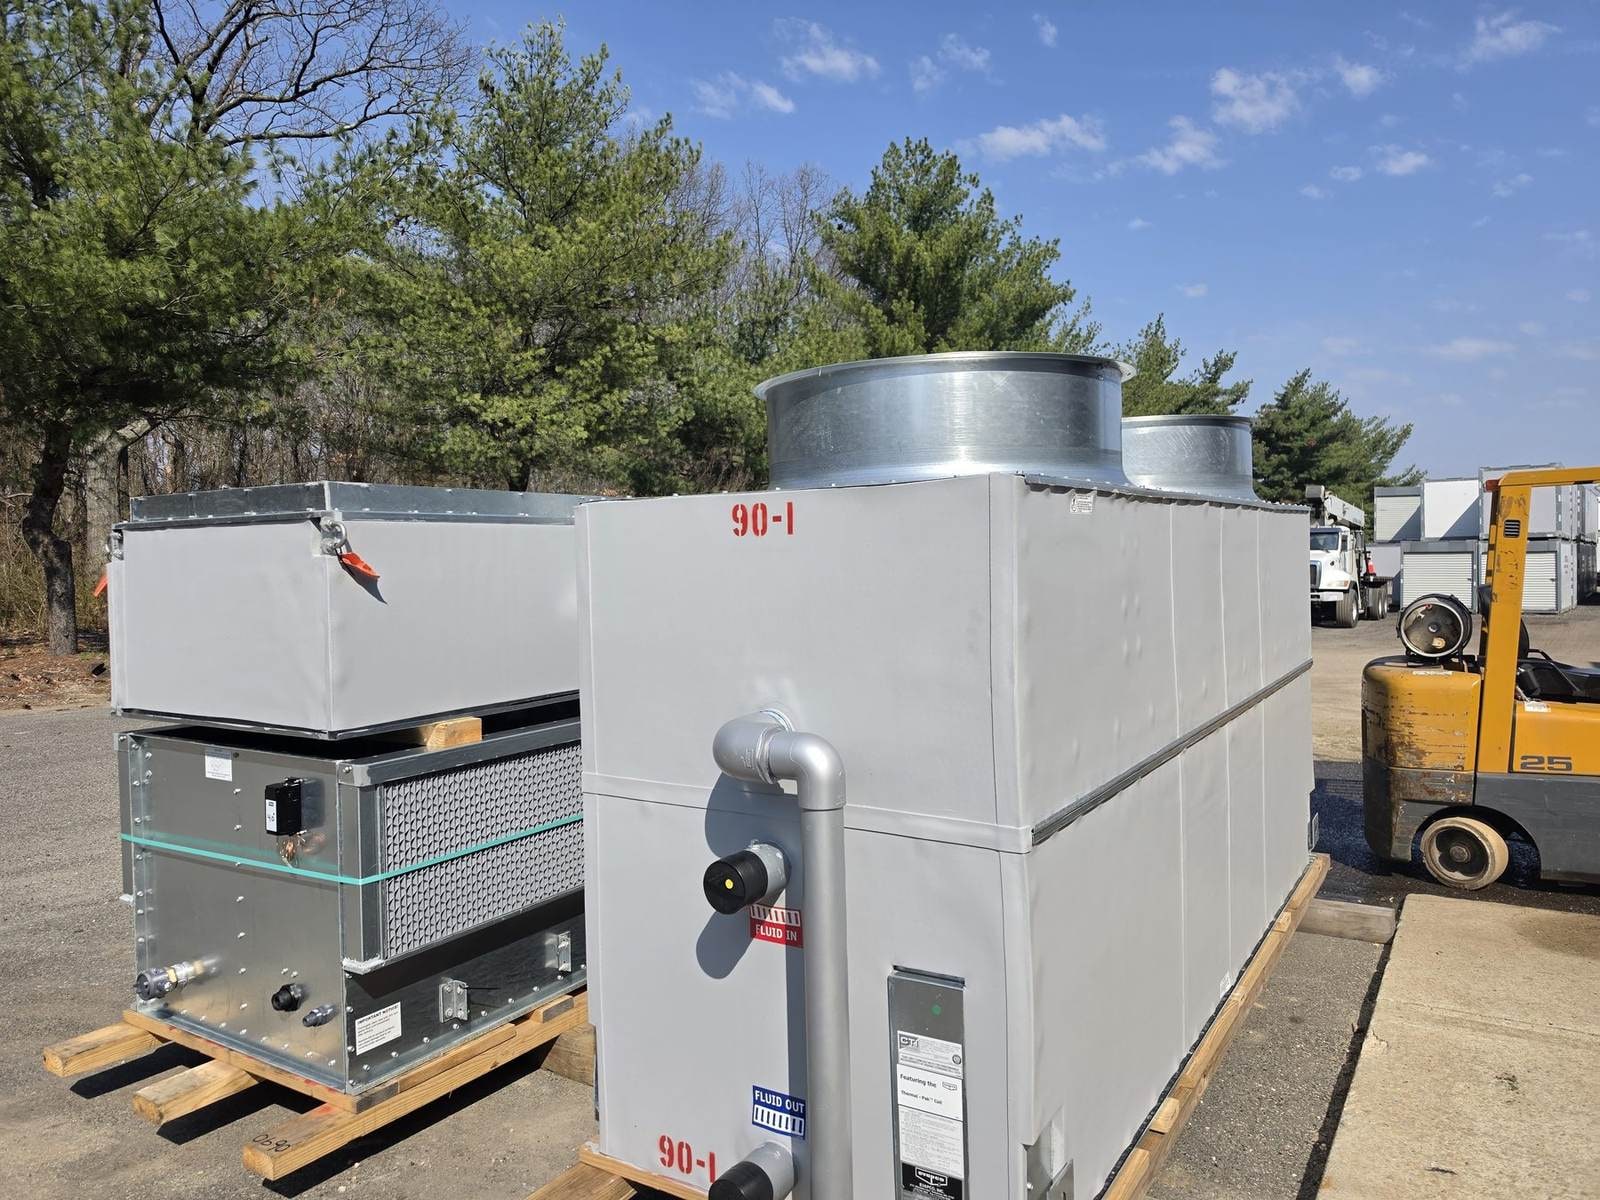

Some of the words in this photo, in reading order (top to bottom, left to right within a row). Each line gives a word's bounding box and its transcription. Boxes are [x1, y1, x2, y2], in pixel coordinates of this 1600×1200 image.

[1520, 755, 1572, 771] 25
[756, 924, 783, 939] FLUID
[786, 930, 797, 941] IN
[900, 1073, 926, 1087] Featuring
[755, 1090, 782, 1107] FLUID
[785, 1098, 804, 1113] OUT
